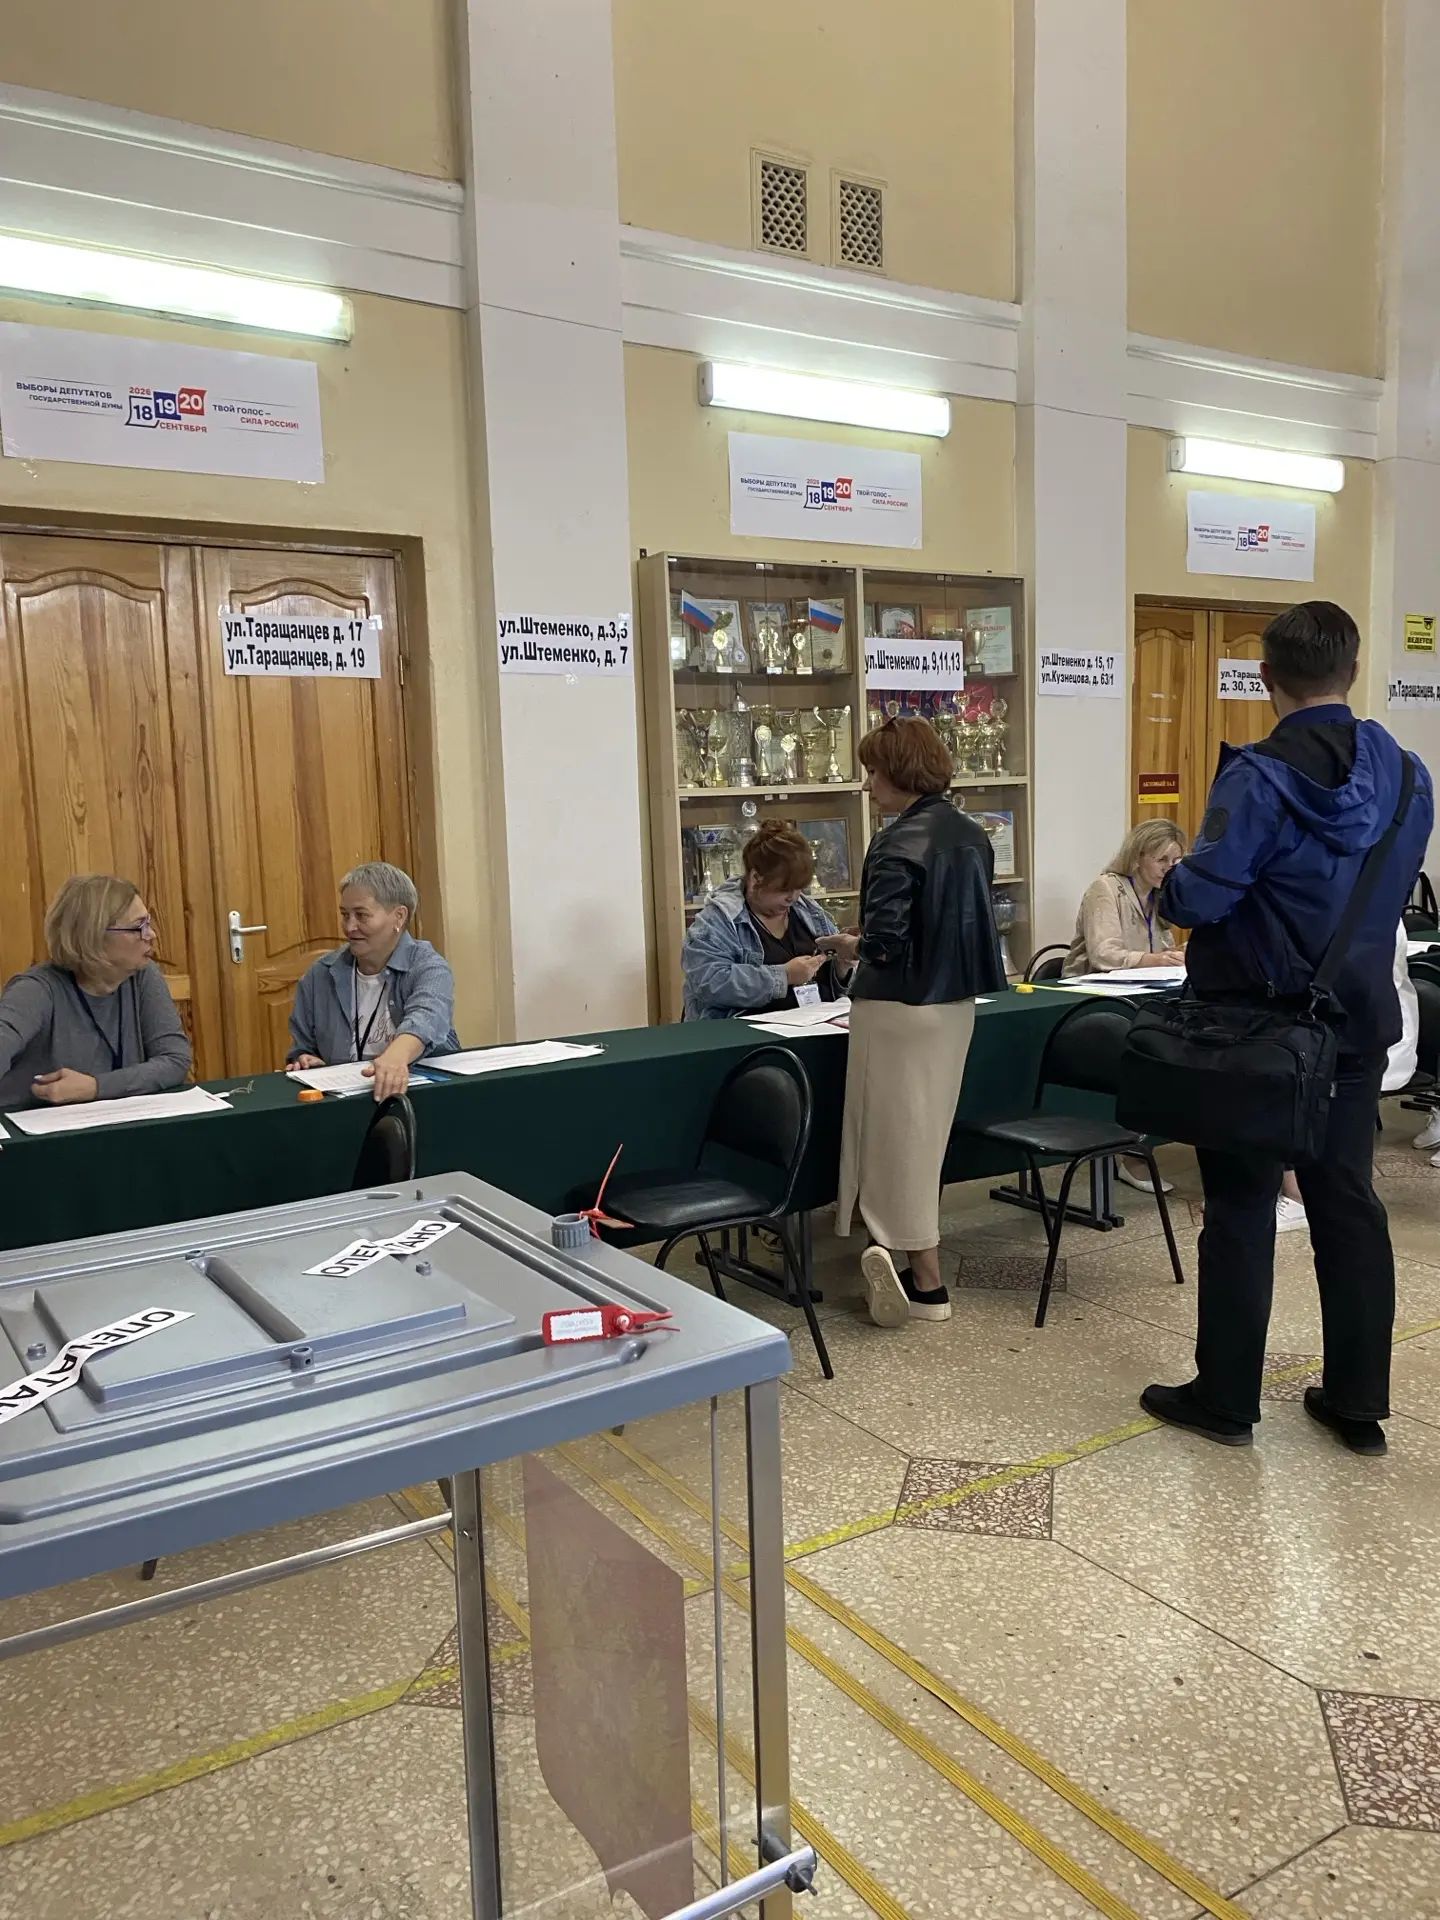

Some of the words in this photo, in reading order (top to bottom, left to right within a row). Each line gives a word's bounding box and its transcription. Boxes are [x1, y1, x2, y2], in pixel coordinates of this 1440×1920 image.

[16, 382, 57, 393] ВЫБОРЫ
[59, 387, 112, 399] ДЕПУТАТОВ
[129, 387, 151, 396] 2026
[29, 394, 100, 407] ГОСУДАРСТВЕННОЙ
[101, 402, 123, 410] ДУМЫ
[133, 404, 153, 421] 18
[156, 398, 176, 415] 19
[179, 393, 203, 410] 20
[212, 404, 235, 413] ТВОЙ
[237, 407, 264, 416] ГОЛОС
[160, 422, 207, 433] СЕНТЯБРЯ
[240, 416, 263, 426] СИЛА
[264, 419, 299, 430] РОССИИ!
[740, 478, 765, 486] ВЫБОРЫ
[765, 480, 797, 489] ДЕПУТАТОВ
[809, 492, 820, 504] 18
[822, 487, 834, 500] 19
[836, 482, 850, 495] 20
[1239, 537, 1248, 547] 18
[1249, 532, 1257, 543] 19
[1257, 530, 1268, 539] 20
[226, 617, 329, 643] ул.Таращанцев
[333, 626, 344, 644] д.
[349, 621, 363, 641] 17
[499, 616, 594, 641] ул.Штеменко,
[227, 644, 333, 671] ул.Таращанцев,
[336, 652, 347, 671] д.
[350, 647, 365, 668] 19
[501, 641, 601, 667] ул.Штеменко,
[604, 650, 616, 667] д.
[620, 646, 628, 664] 7
[864, 649, 920, 674] ул.Штеменко
[922, 656, 930, 674] д.
[931, 651, 960, 675] 9,11,13
[1041, 653, 1085, 669] ул.Штеменко
[1087, 658, 1093, 670] д.
[1095, 656, 1104, 671] 15,
[1106, 657, 1114, 669] 17
[1092, 675, 1099, 686] д.
[1220, 670, 1262, 680] ул.Тараща
[1220, 683, 1229, 692] д.
[1232, 681, 1246, 693] 30,
[1249, 681, 1264, 694] 32,
[320, 1223, 447, 1275] ОПЕТАНО
